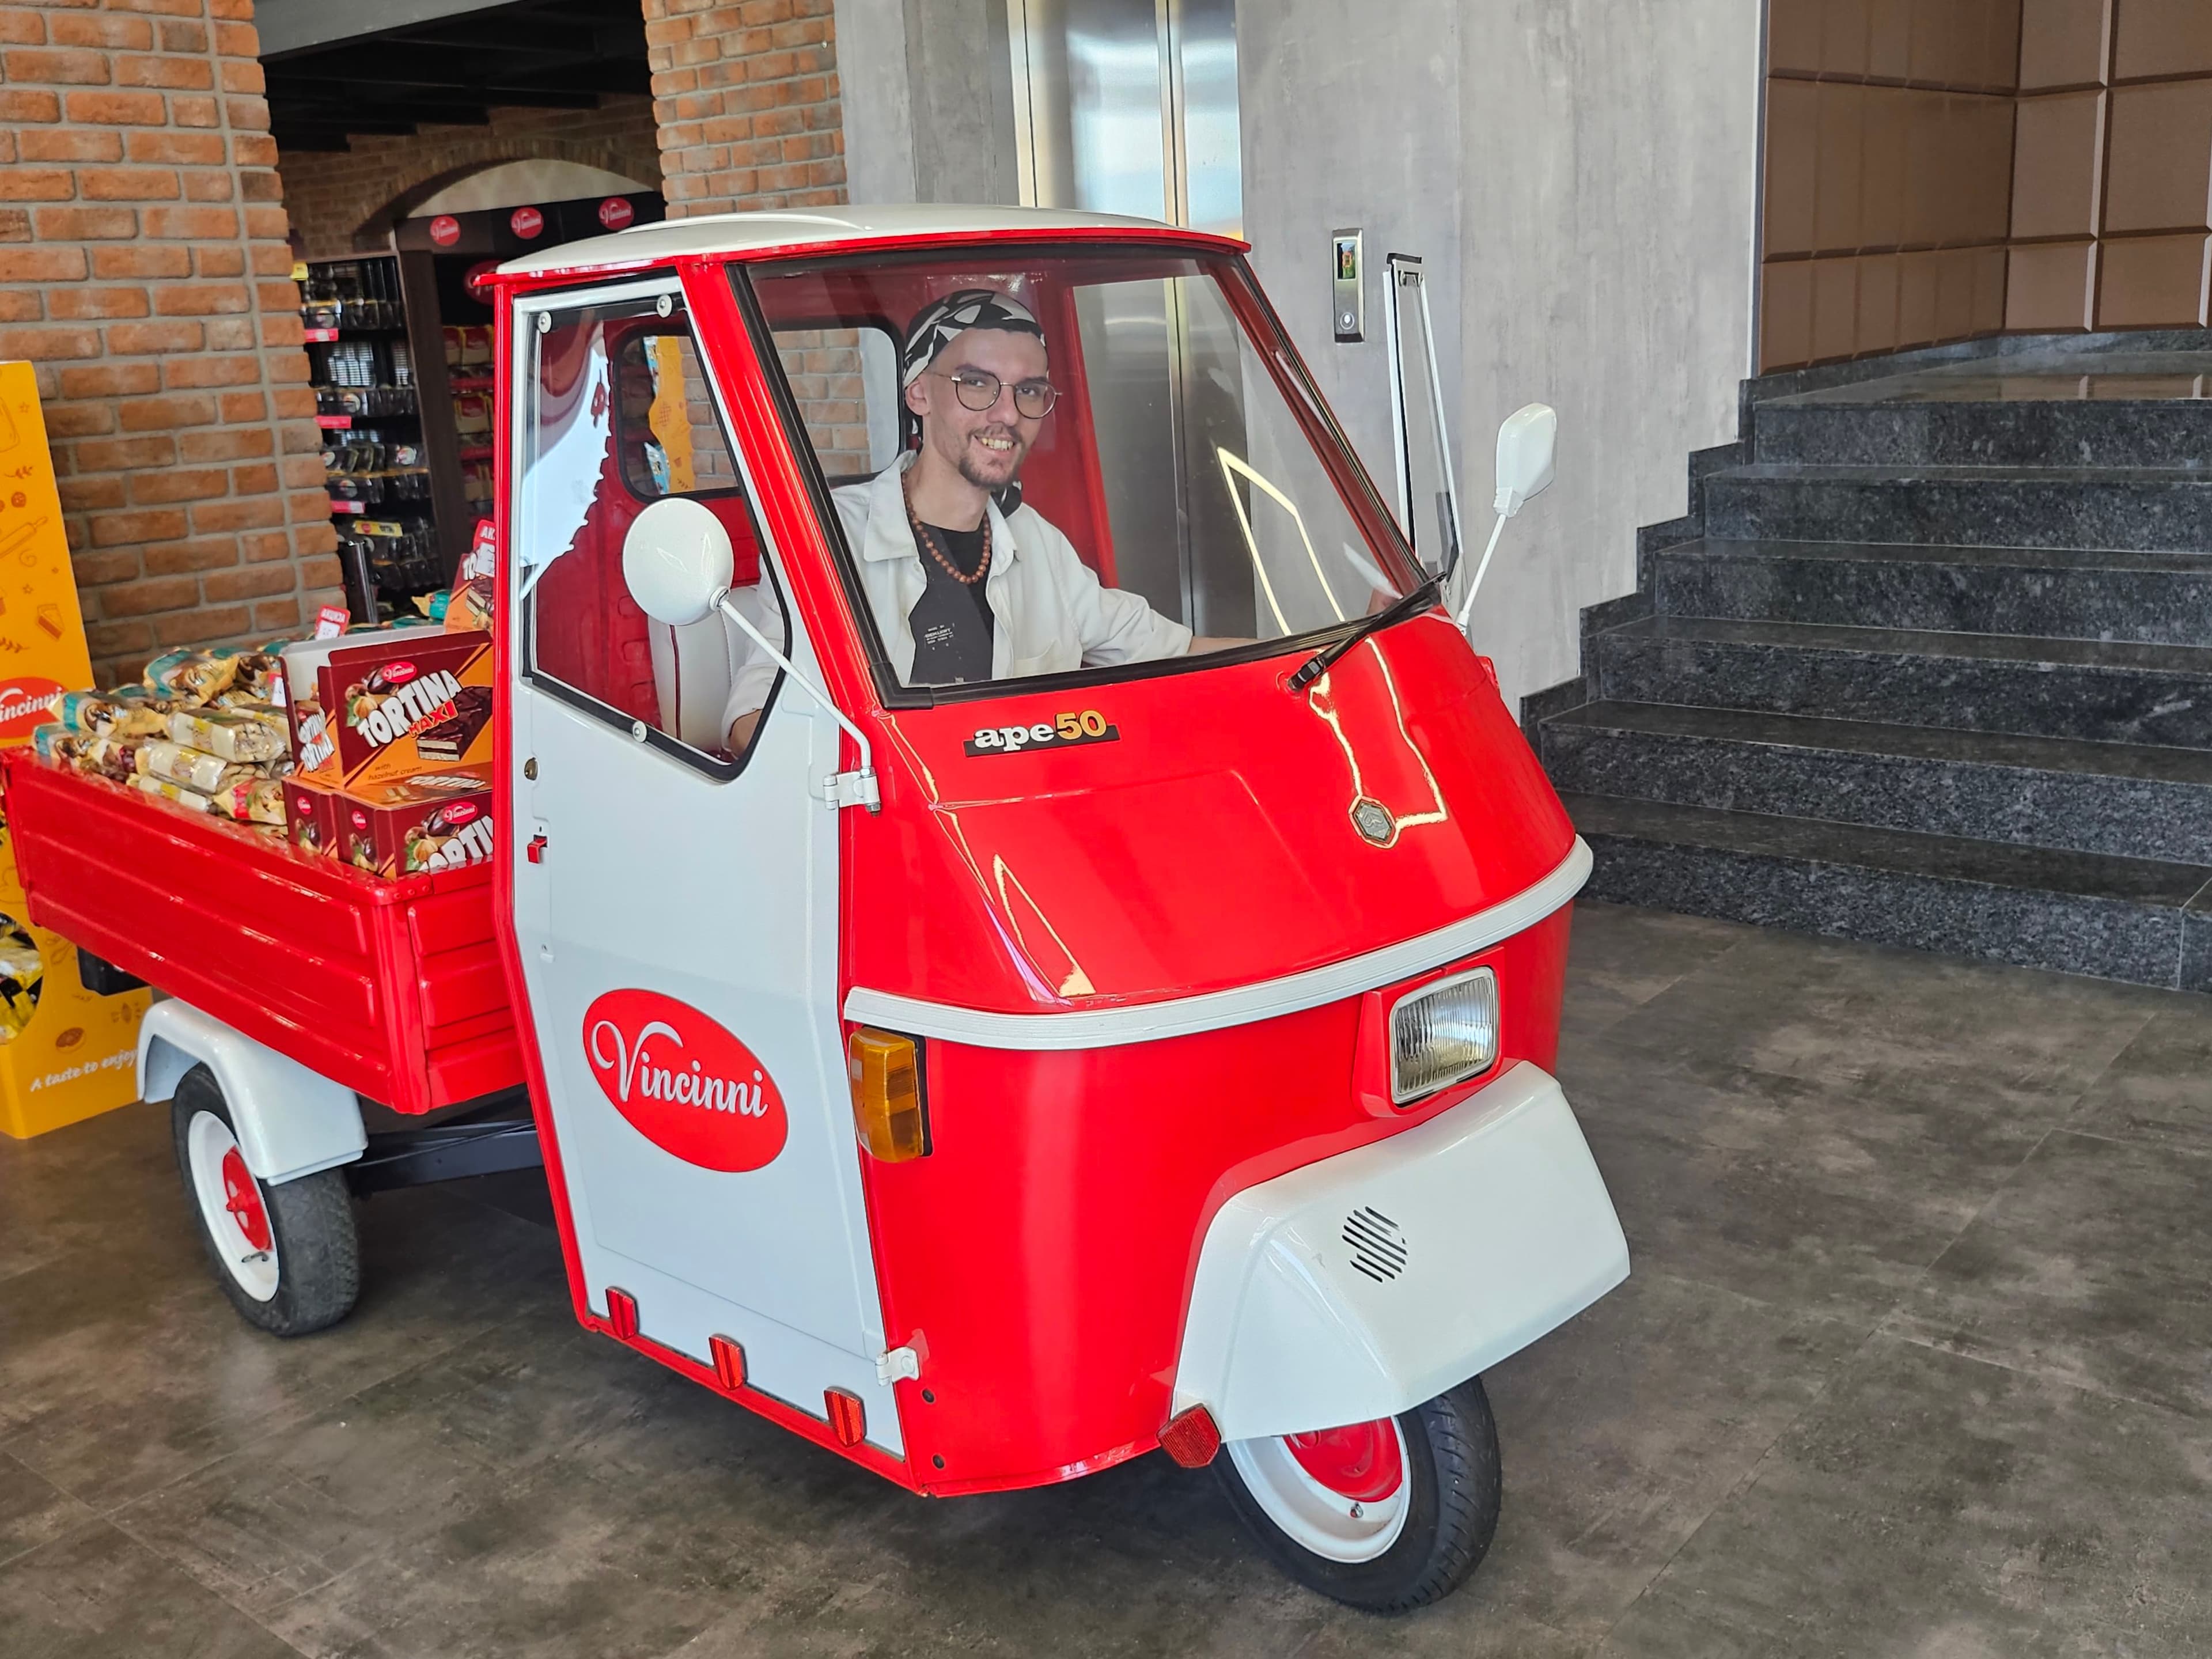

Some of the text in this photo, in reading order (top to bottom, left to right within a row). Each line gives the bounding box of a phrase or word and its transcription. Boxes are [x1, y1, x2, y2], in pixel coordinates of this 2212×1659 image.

[357, 669, 464, 748] TORTINA
[407, 699, 459, 738] MAXI
[974, 710, 1107, 752] ape 50
[30, 1078, 42, 1093] A
[45, 1067, 81, 1088] taste
[83, 1062, 99, 1074] to
[591, 1020, 769, 1118] Vincinni
